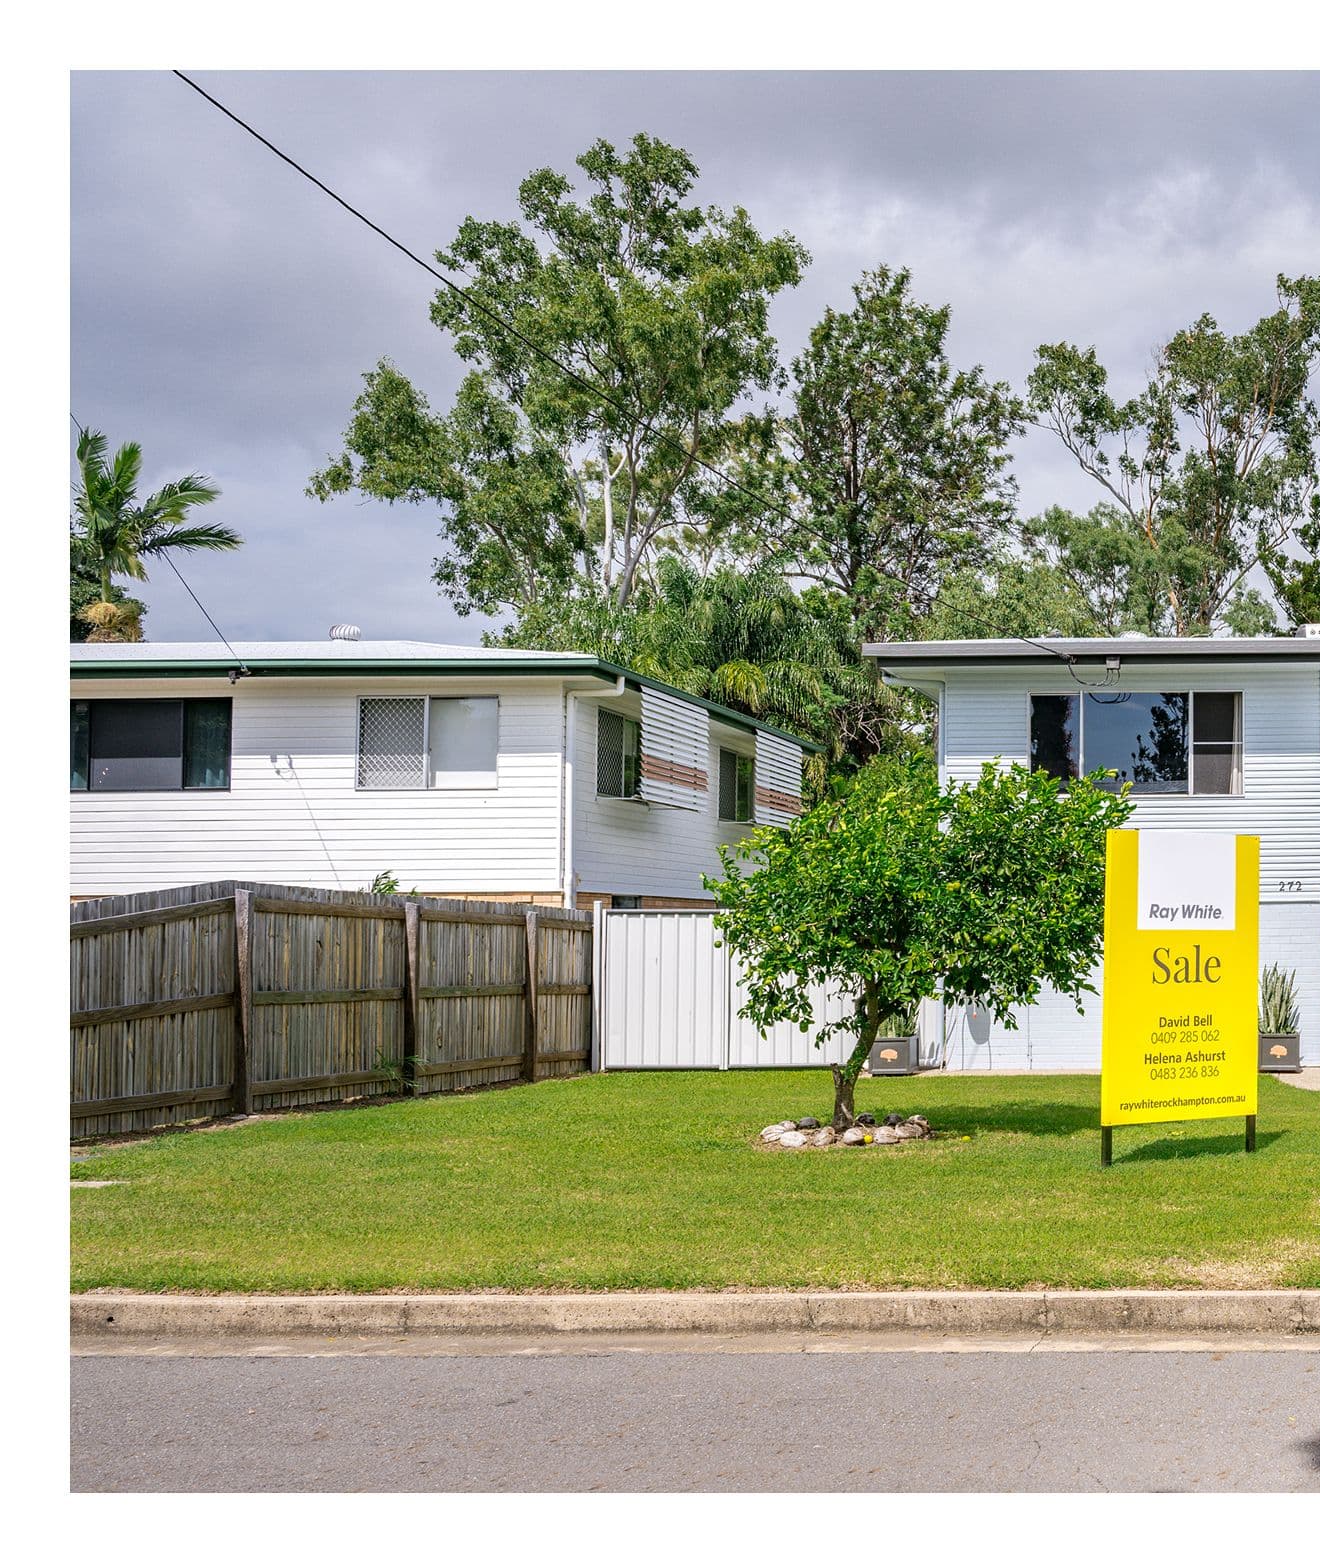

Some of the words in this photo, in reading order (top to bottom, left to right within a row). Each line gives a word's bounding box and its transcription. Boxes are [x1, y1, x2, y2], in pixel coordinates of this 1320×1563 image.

[1279, 881, 1302, 892] 272
[1149, 903, 1179, 922] Ray
[1181, 904, 1222, 920] White
[1152, 944, 1221, 984] Sale
[1159, 1015, 1190, 1028] David
[1193, 1014, 1213, 1027] Bell
[1150, 1031, 1177, 1044] 0409
[1179, 1030, 1199, 1043] 285
[1200, 1029, 1220, 1042] 062
[1144, 1053, 1182, 1065] Helena
[1185, 1050, 1226, 1063] Ashurst
[1150, 1068, 1176, 1081] 0483
[1179, 1067, 1198, 1079] 236
[1200, 1065, 1220, 1078] 836
[1119, 1094, 1246, 1112] raywhiterockhampton.com.au
